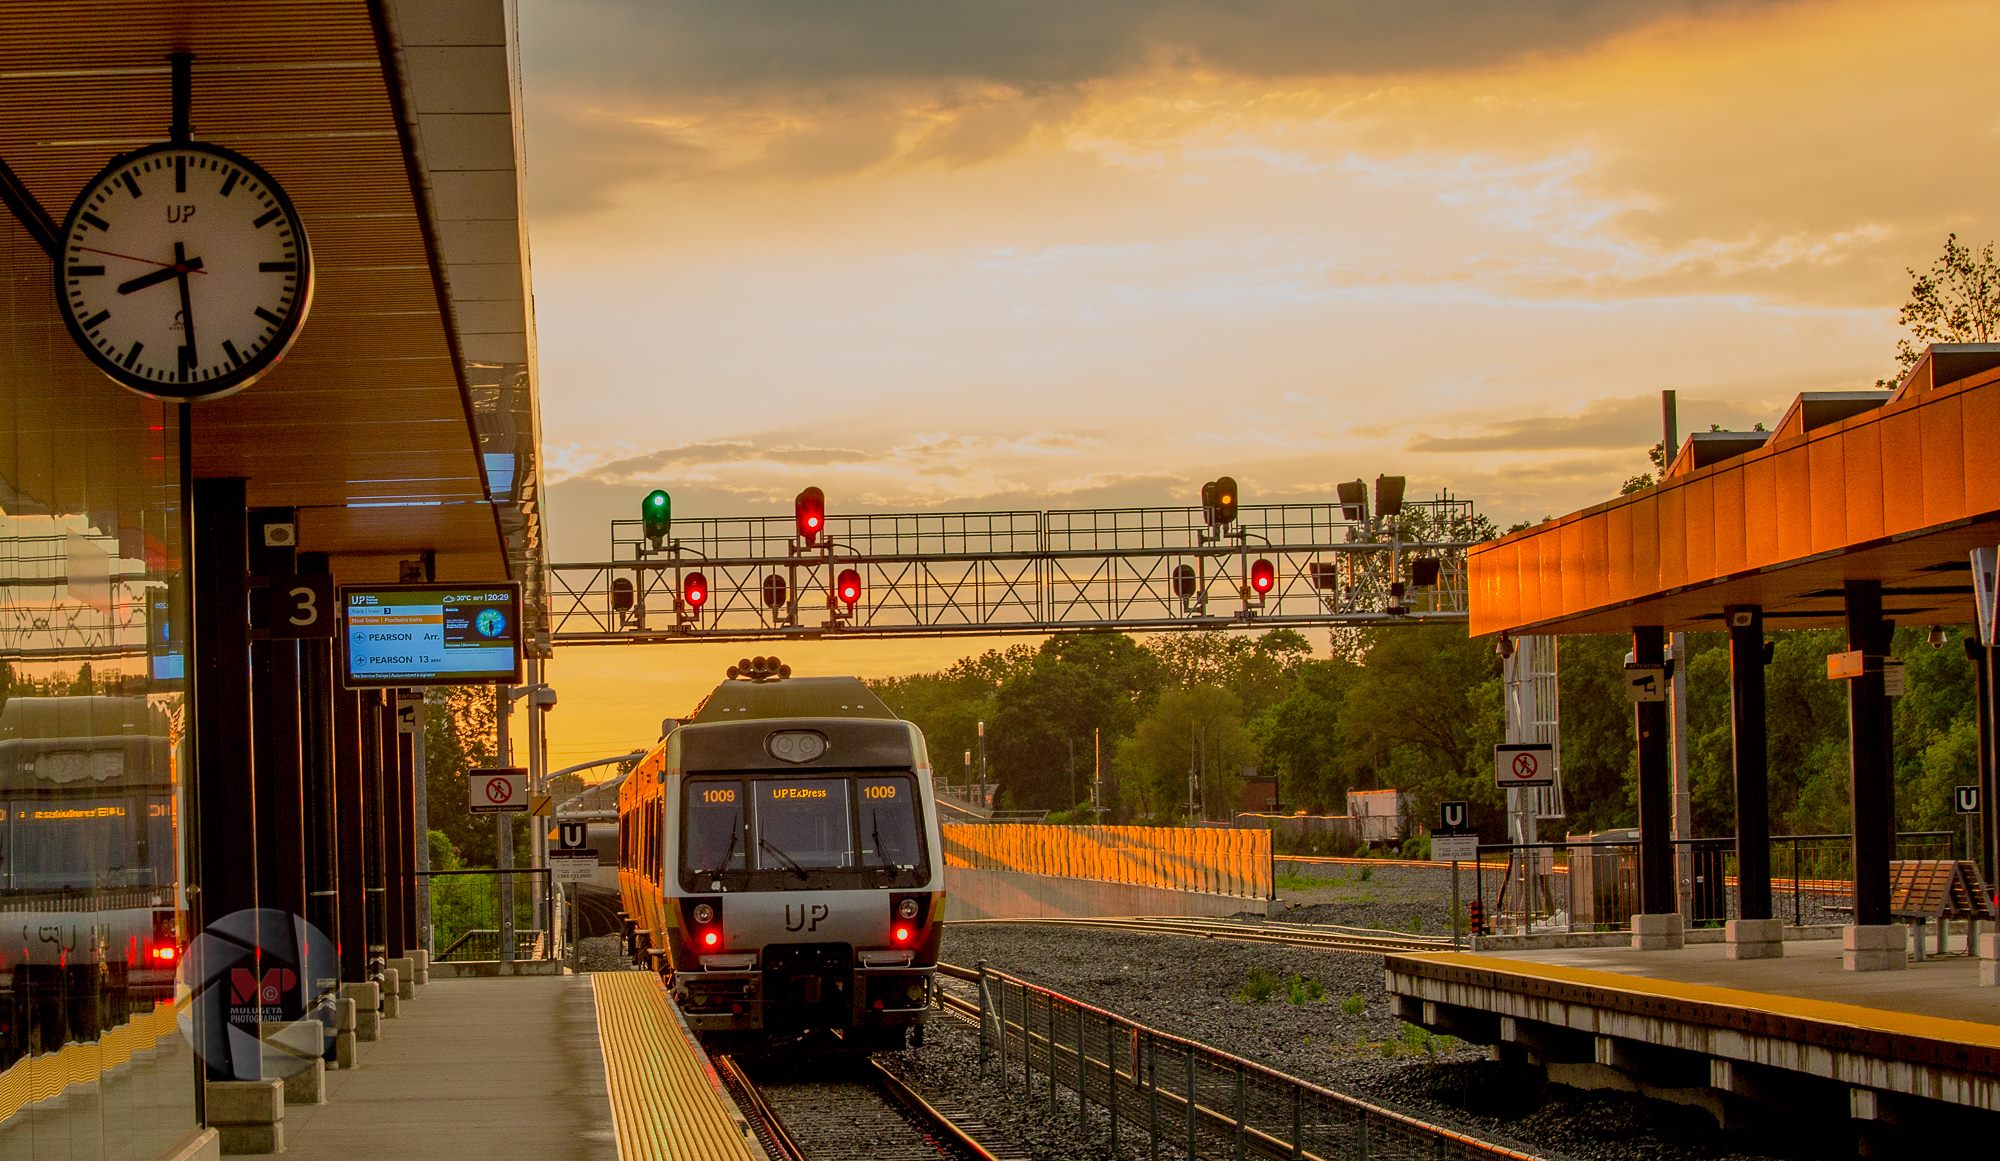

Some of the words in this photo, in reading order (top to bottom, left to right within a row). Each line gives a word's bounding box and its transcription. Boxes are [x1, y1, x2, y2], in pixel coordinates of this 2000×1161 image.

[167, 204, 196, 224] UP
[351, 595, 365, 605] UP
[487, 593, 509, 601] 20:29
[288, 586, 318, 626] 3
[369, 633, 412, 641] PEARSON
[369, 656, 413, 664] PEARSON
[418, 655, 429, 663] 13
[703, 789, 735, 803] 1009
[773, 788, 790, 798] UP
[864, 785, 896, 799] 1009
[1960, 790, 1977, 810] U
[1445, 805, 1463, 826] U
[564, 826, 582, 847] U
[785, 903, 830, 933] UP
